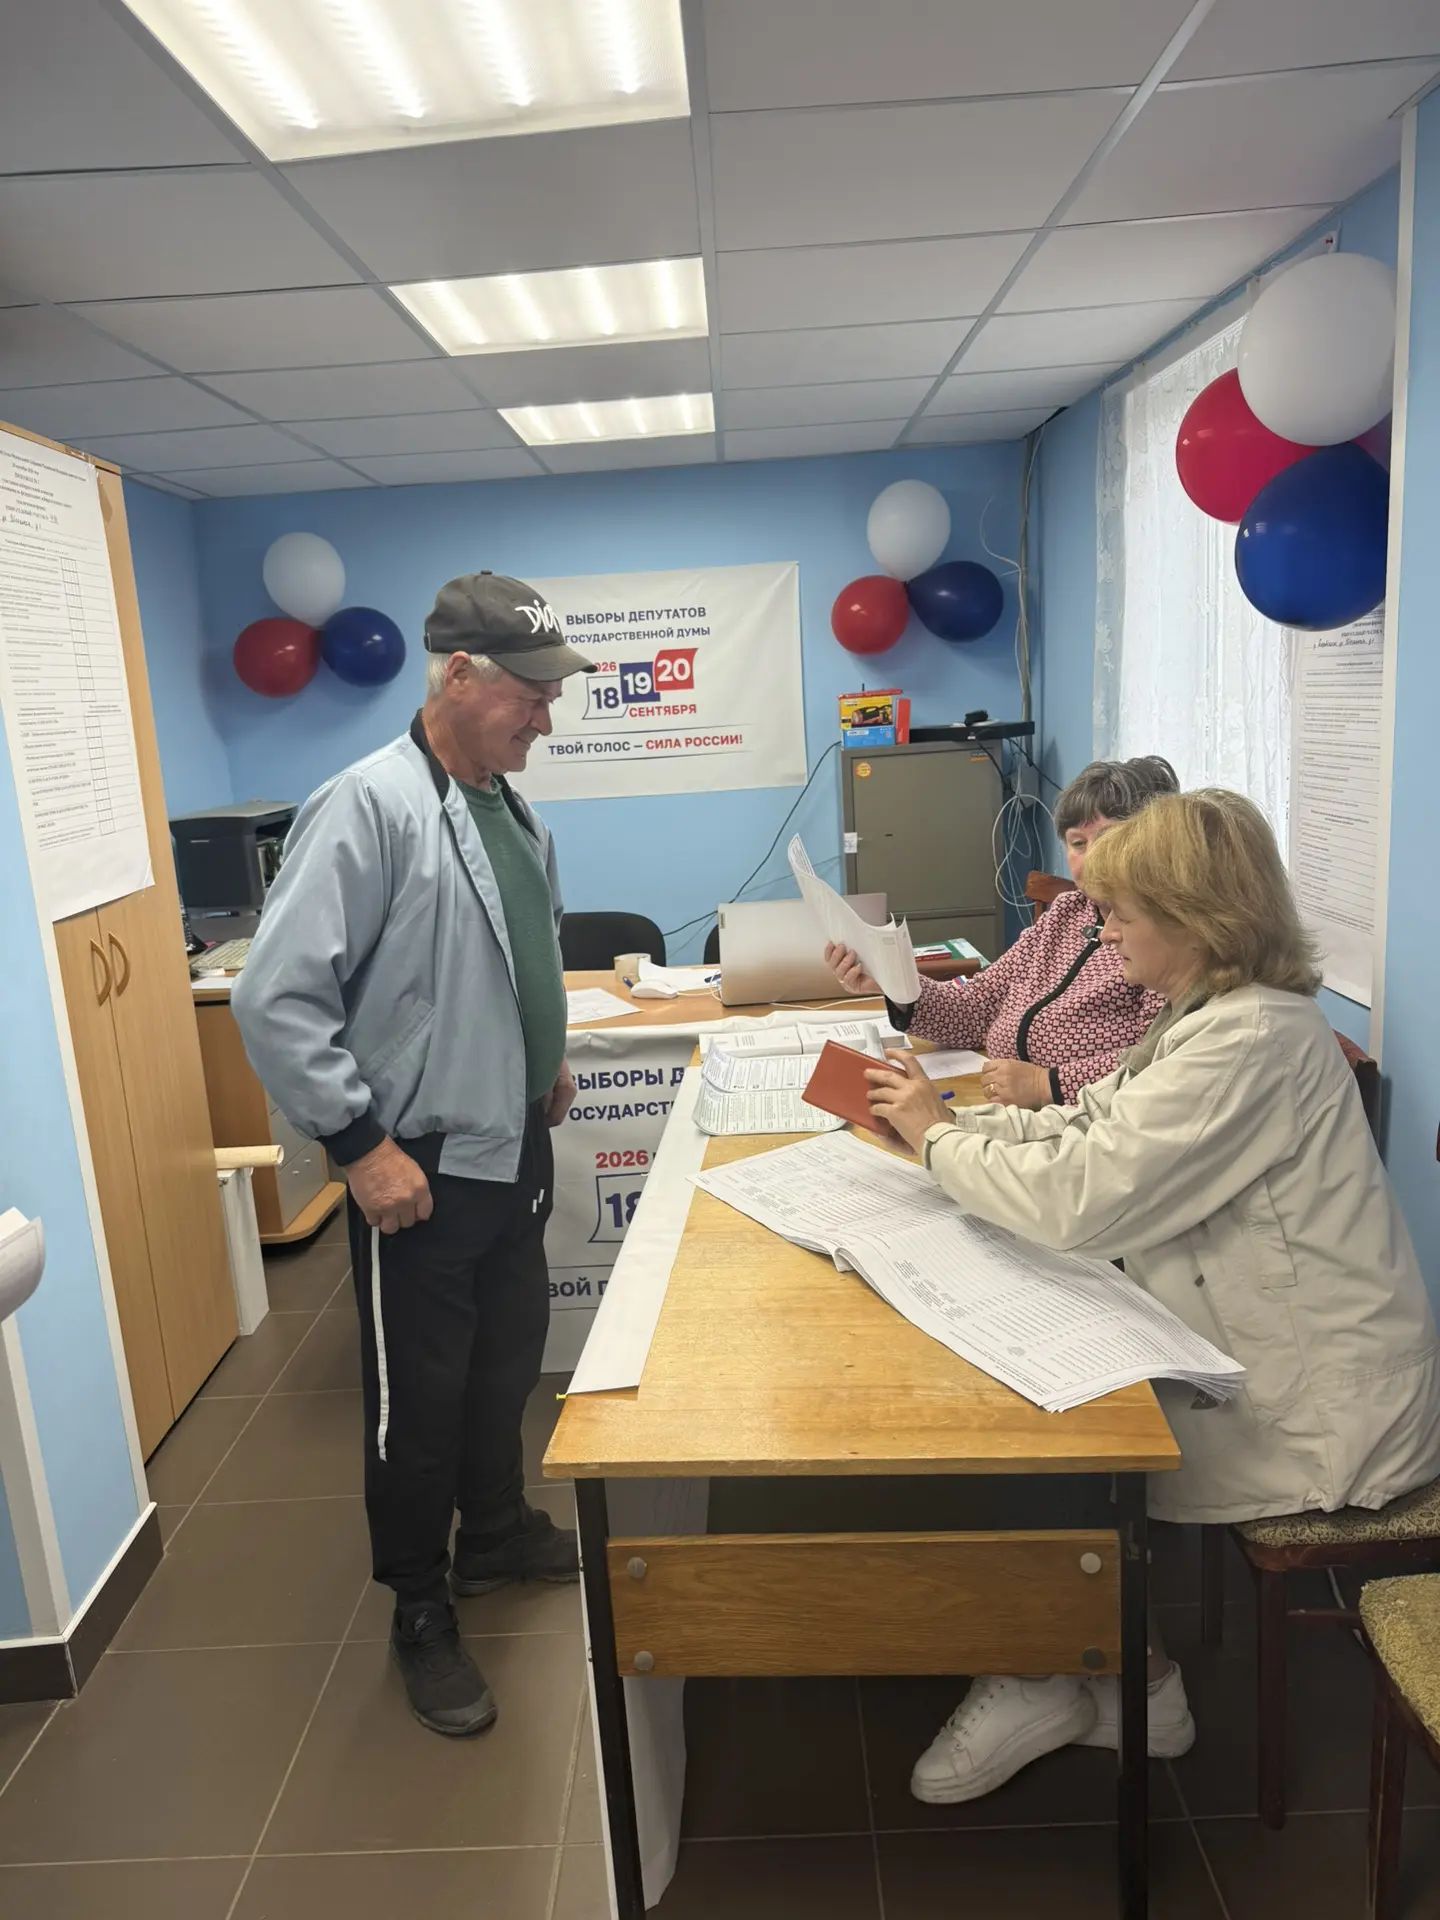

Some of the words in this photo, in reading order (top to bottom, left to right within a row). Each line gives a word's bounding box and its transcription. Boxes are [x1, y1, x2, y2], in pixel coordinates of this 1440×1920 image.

[566, 612, 625, 626] ВЫБОРЫ
[628, 607, 707, 623] ДЕПУТАТОВ
[565, 627, 674, 644] ГОСУДАРСТВЕННОЙ
[676, 627, 710, 638] ДУМЫ
[657, 658, 691, 682] 20
[623, 671, 652, 695] 19
[592, 687, 619, 709] 18
[629, 704, 697, 717] СЕНТЯБРЯ
[548, 742, 584, 755] ТВОЙ
[587, 741, 631, 753] ГОЛОС
[645, 738, 681, 750] СИЛА
[685, 734, 743, 747] РОССИИ!
[572, 1068, 664, 1090] ЫБОРЫ
[595, 1150, 649, 1169] 2026
